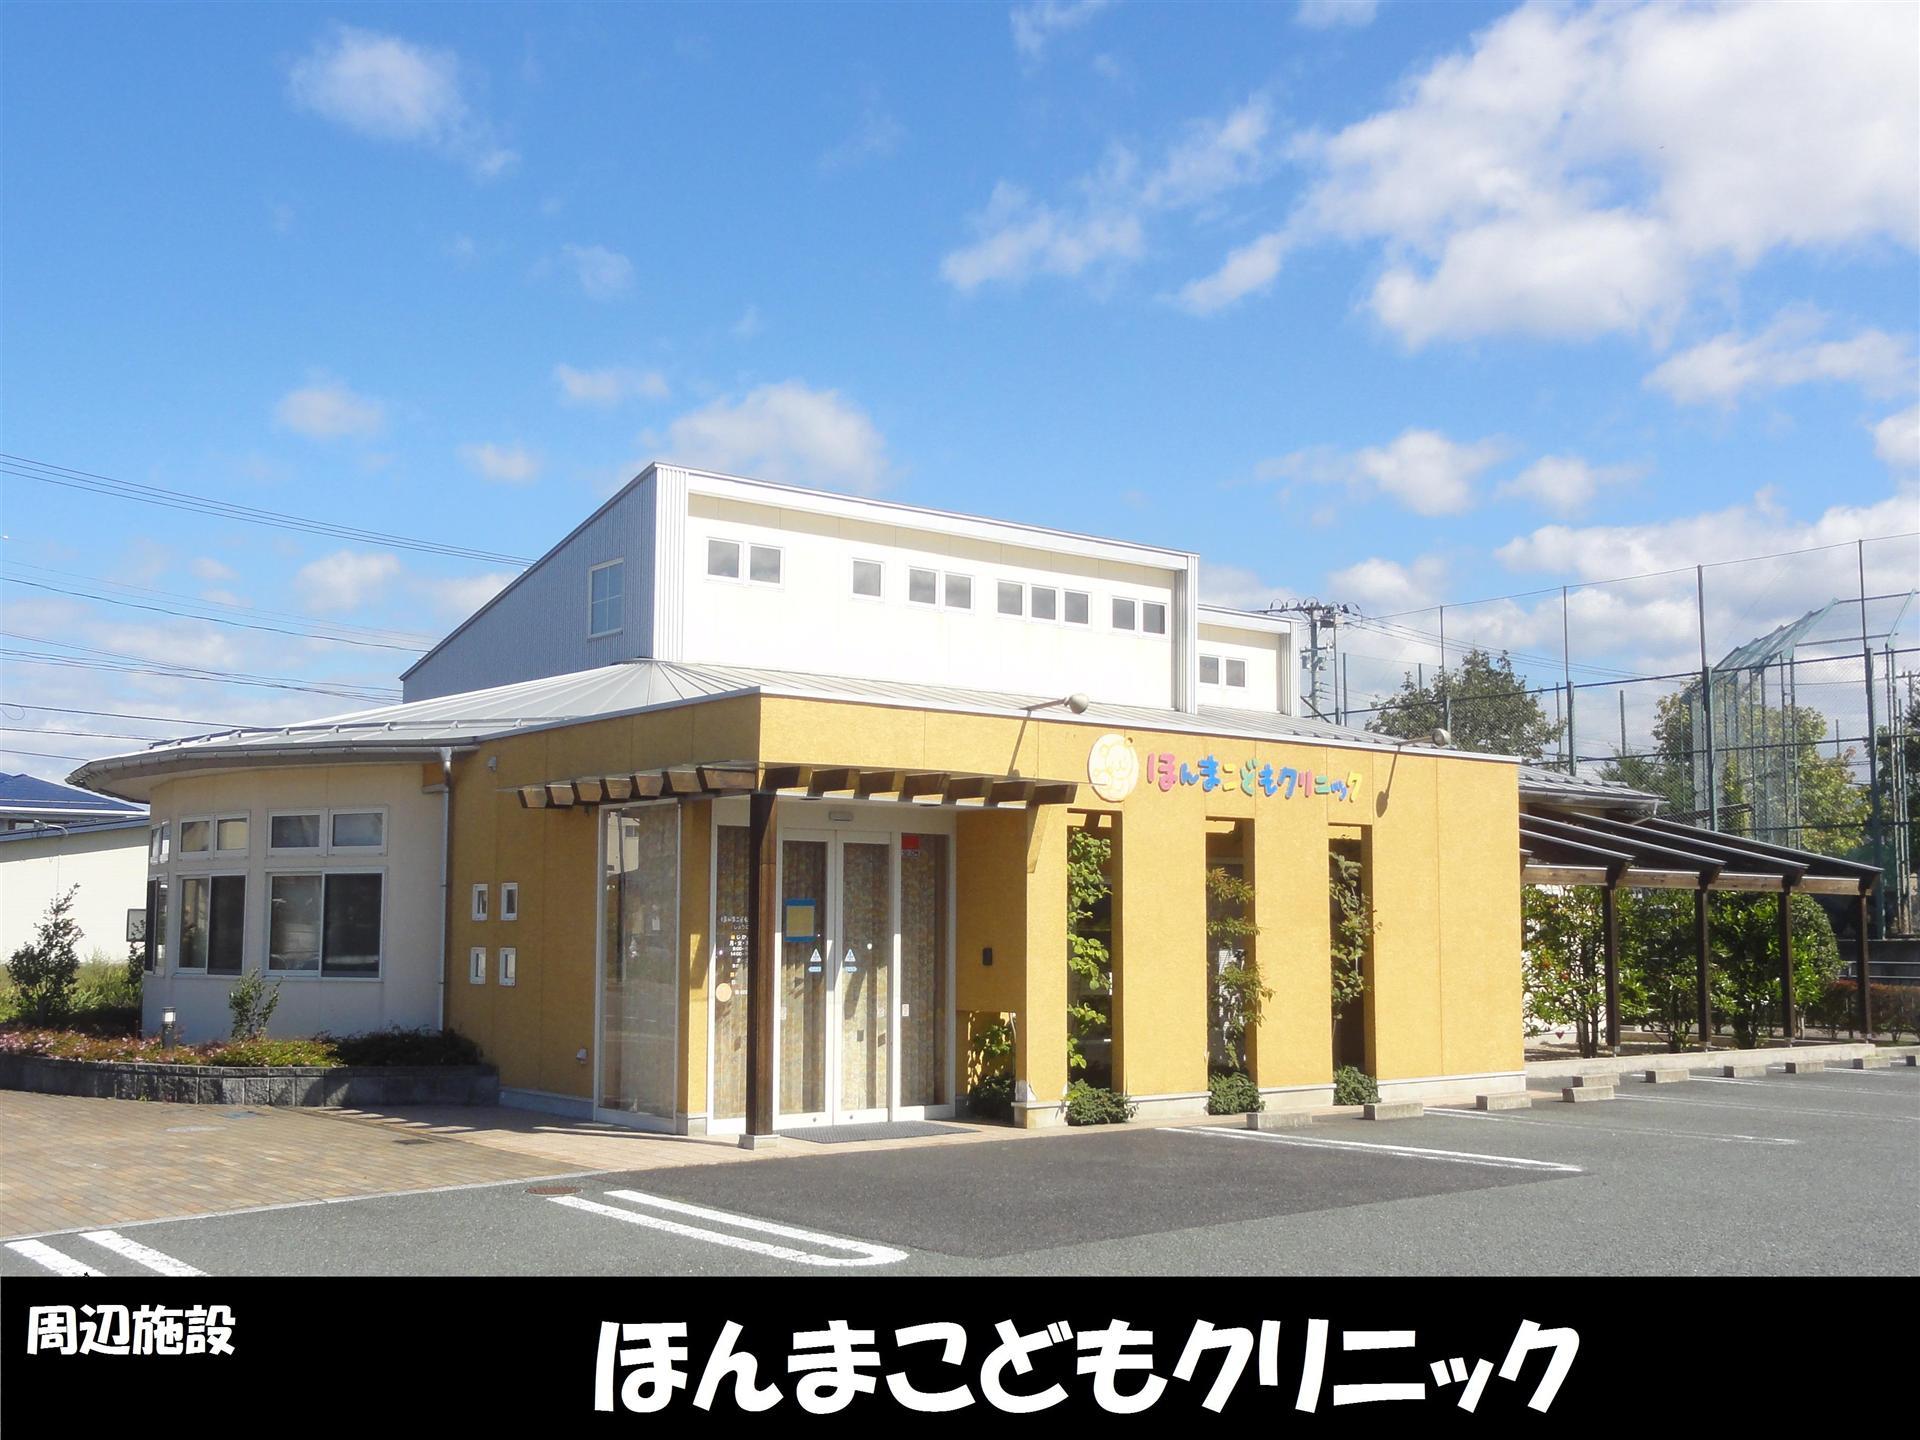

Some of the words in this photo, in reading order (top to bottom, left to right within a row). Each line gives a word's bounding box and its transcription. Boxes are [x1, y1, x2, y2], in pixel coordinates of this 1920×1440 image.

[1147, 752, 1363, 803] ほんまこどもクリニック
